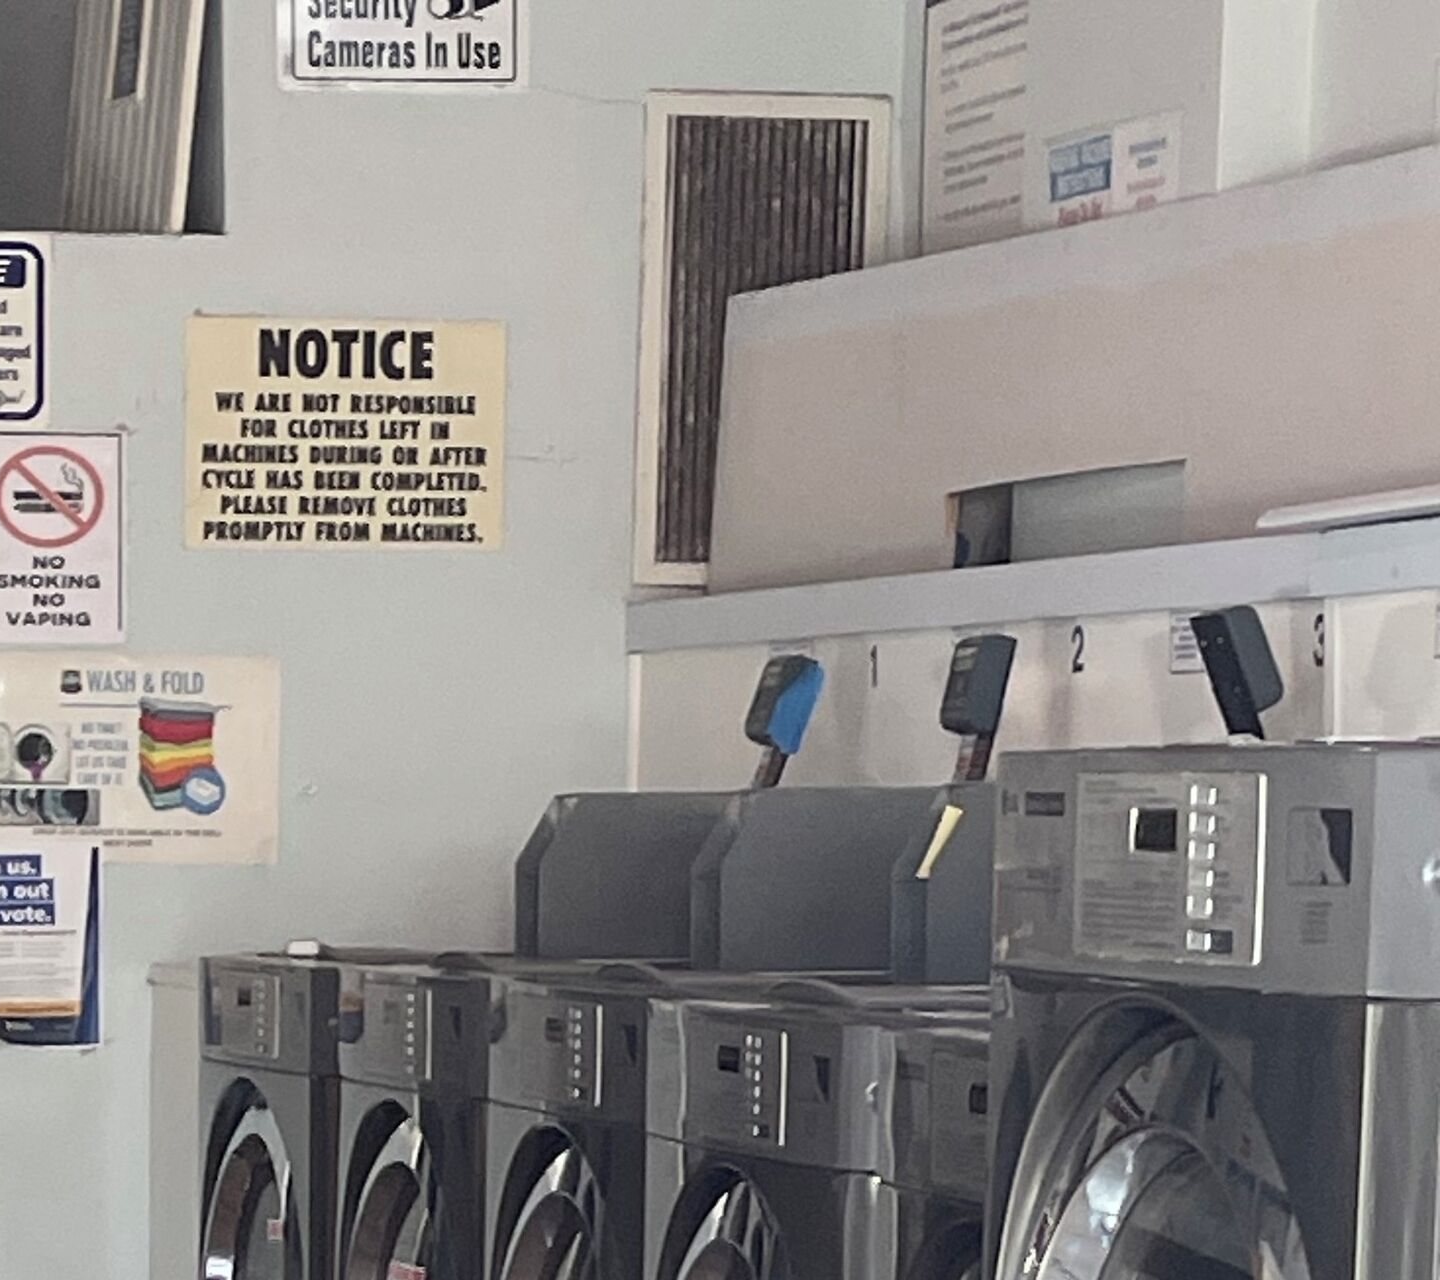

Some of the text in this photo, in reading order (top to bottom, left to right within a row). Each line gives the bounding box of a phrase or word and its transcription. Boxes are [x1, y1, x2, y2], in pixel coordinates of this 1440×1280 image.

[308, 30, 502, 69] Cameras In Use
[0, 324, 23, 336] are
[259, 328, 434, 380] NOTICE
[216, 392, 475, 416] WE ARE NOT RESPONSIBLE
[241, 418, 450, 440] FOR CLOTHES LEFT IN
[202, 444, 486, 467] MACHINES DURING OR AFTER
[202, 468, 487, 492] CYCLE HAS BEEN COMPLETED.
[221, 494, 466, 517] PLEASE REMOVE CLOTHES
[203, 521, 483, 543] PROMPTLY FROM MACHINES.
[32, 556, 65, 570] NO
[32, 593, 65, 607] NO
[6, 612, 91, 626] VAPING
[1071, 626, 1086, 674] 2
[1312, 613, 1326, 667] 3
[870, 645, 878, 688] 1
[86, 670, 204, 694] WASH & FOLD
[7, 861, 37, 875] us.
[13, 883, 50, 899] out
[0, 907, 51, 923] vote.
